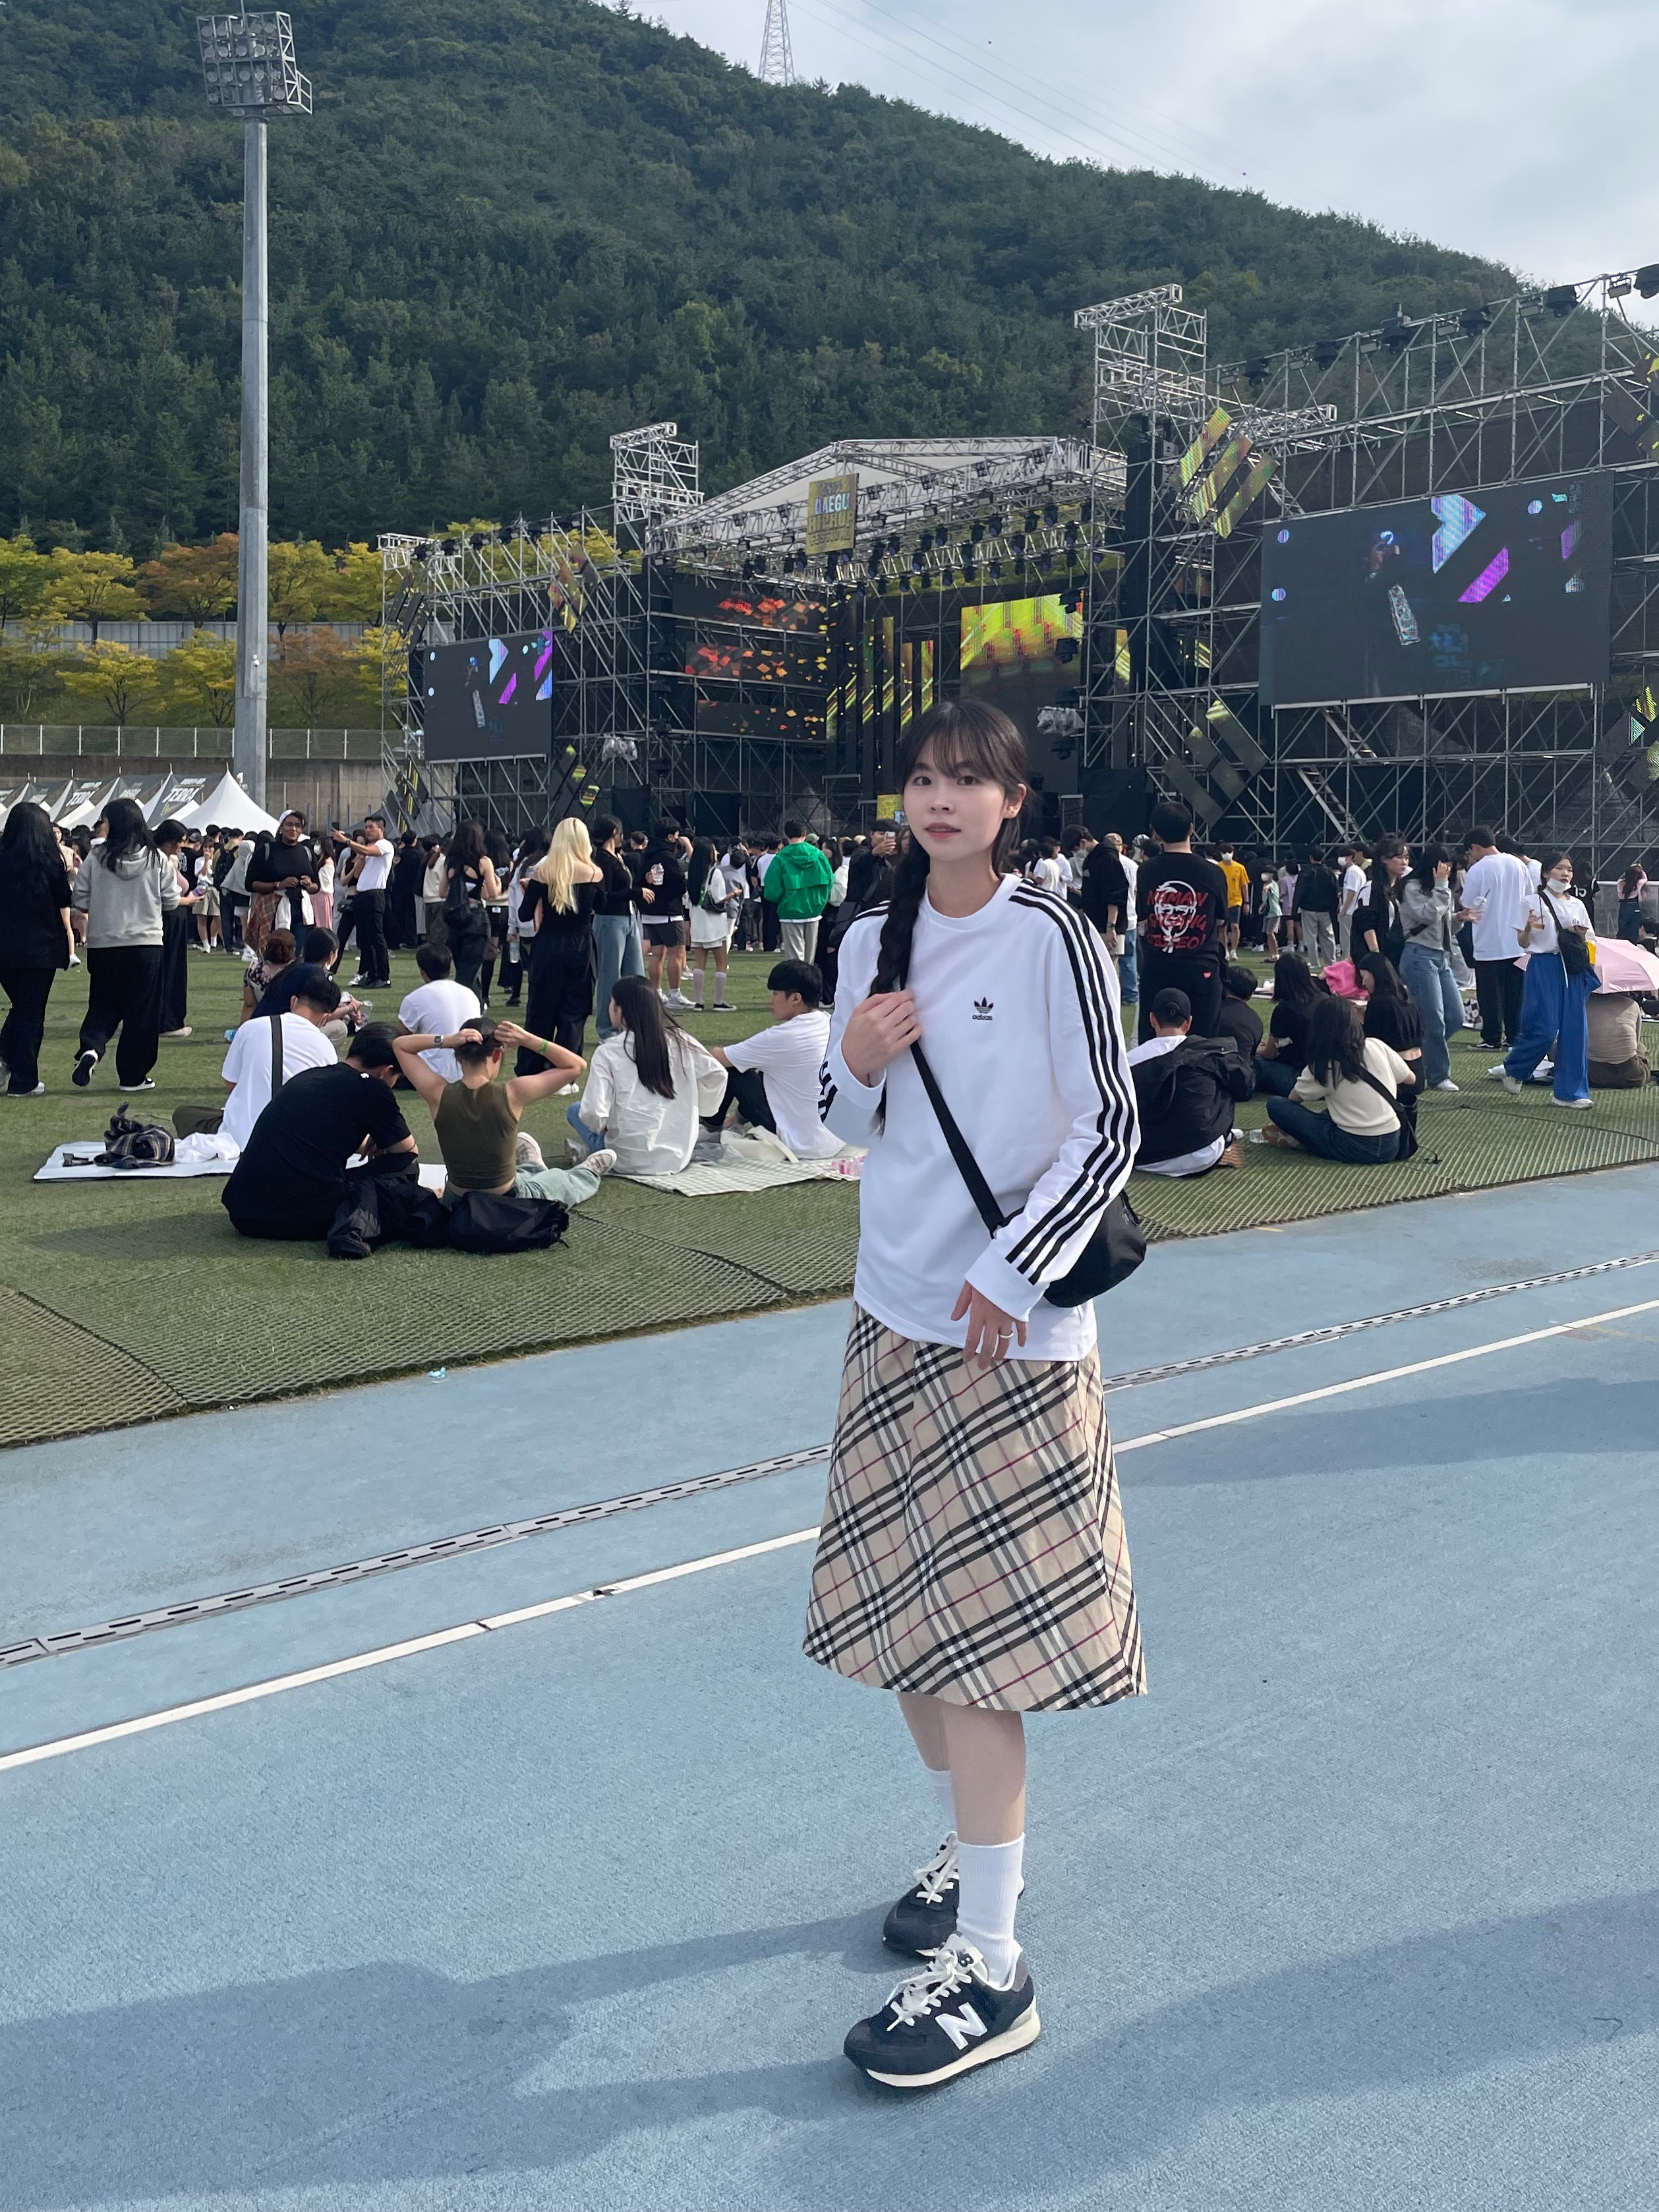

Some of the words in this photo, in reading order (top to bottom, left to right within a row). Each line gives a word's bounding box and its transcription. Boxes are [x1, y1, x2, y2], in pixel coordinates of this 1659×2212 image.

[815, 493, 850, 515] DAEGU
[808, 510, 854, 534] HIPHOP
[162, 788, 200, 803] TERRA
[1573, 884, 1587, 897] 15
[935, 2002, 988, 2050] N
